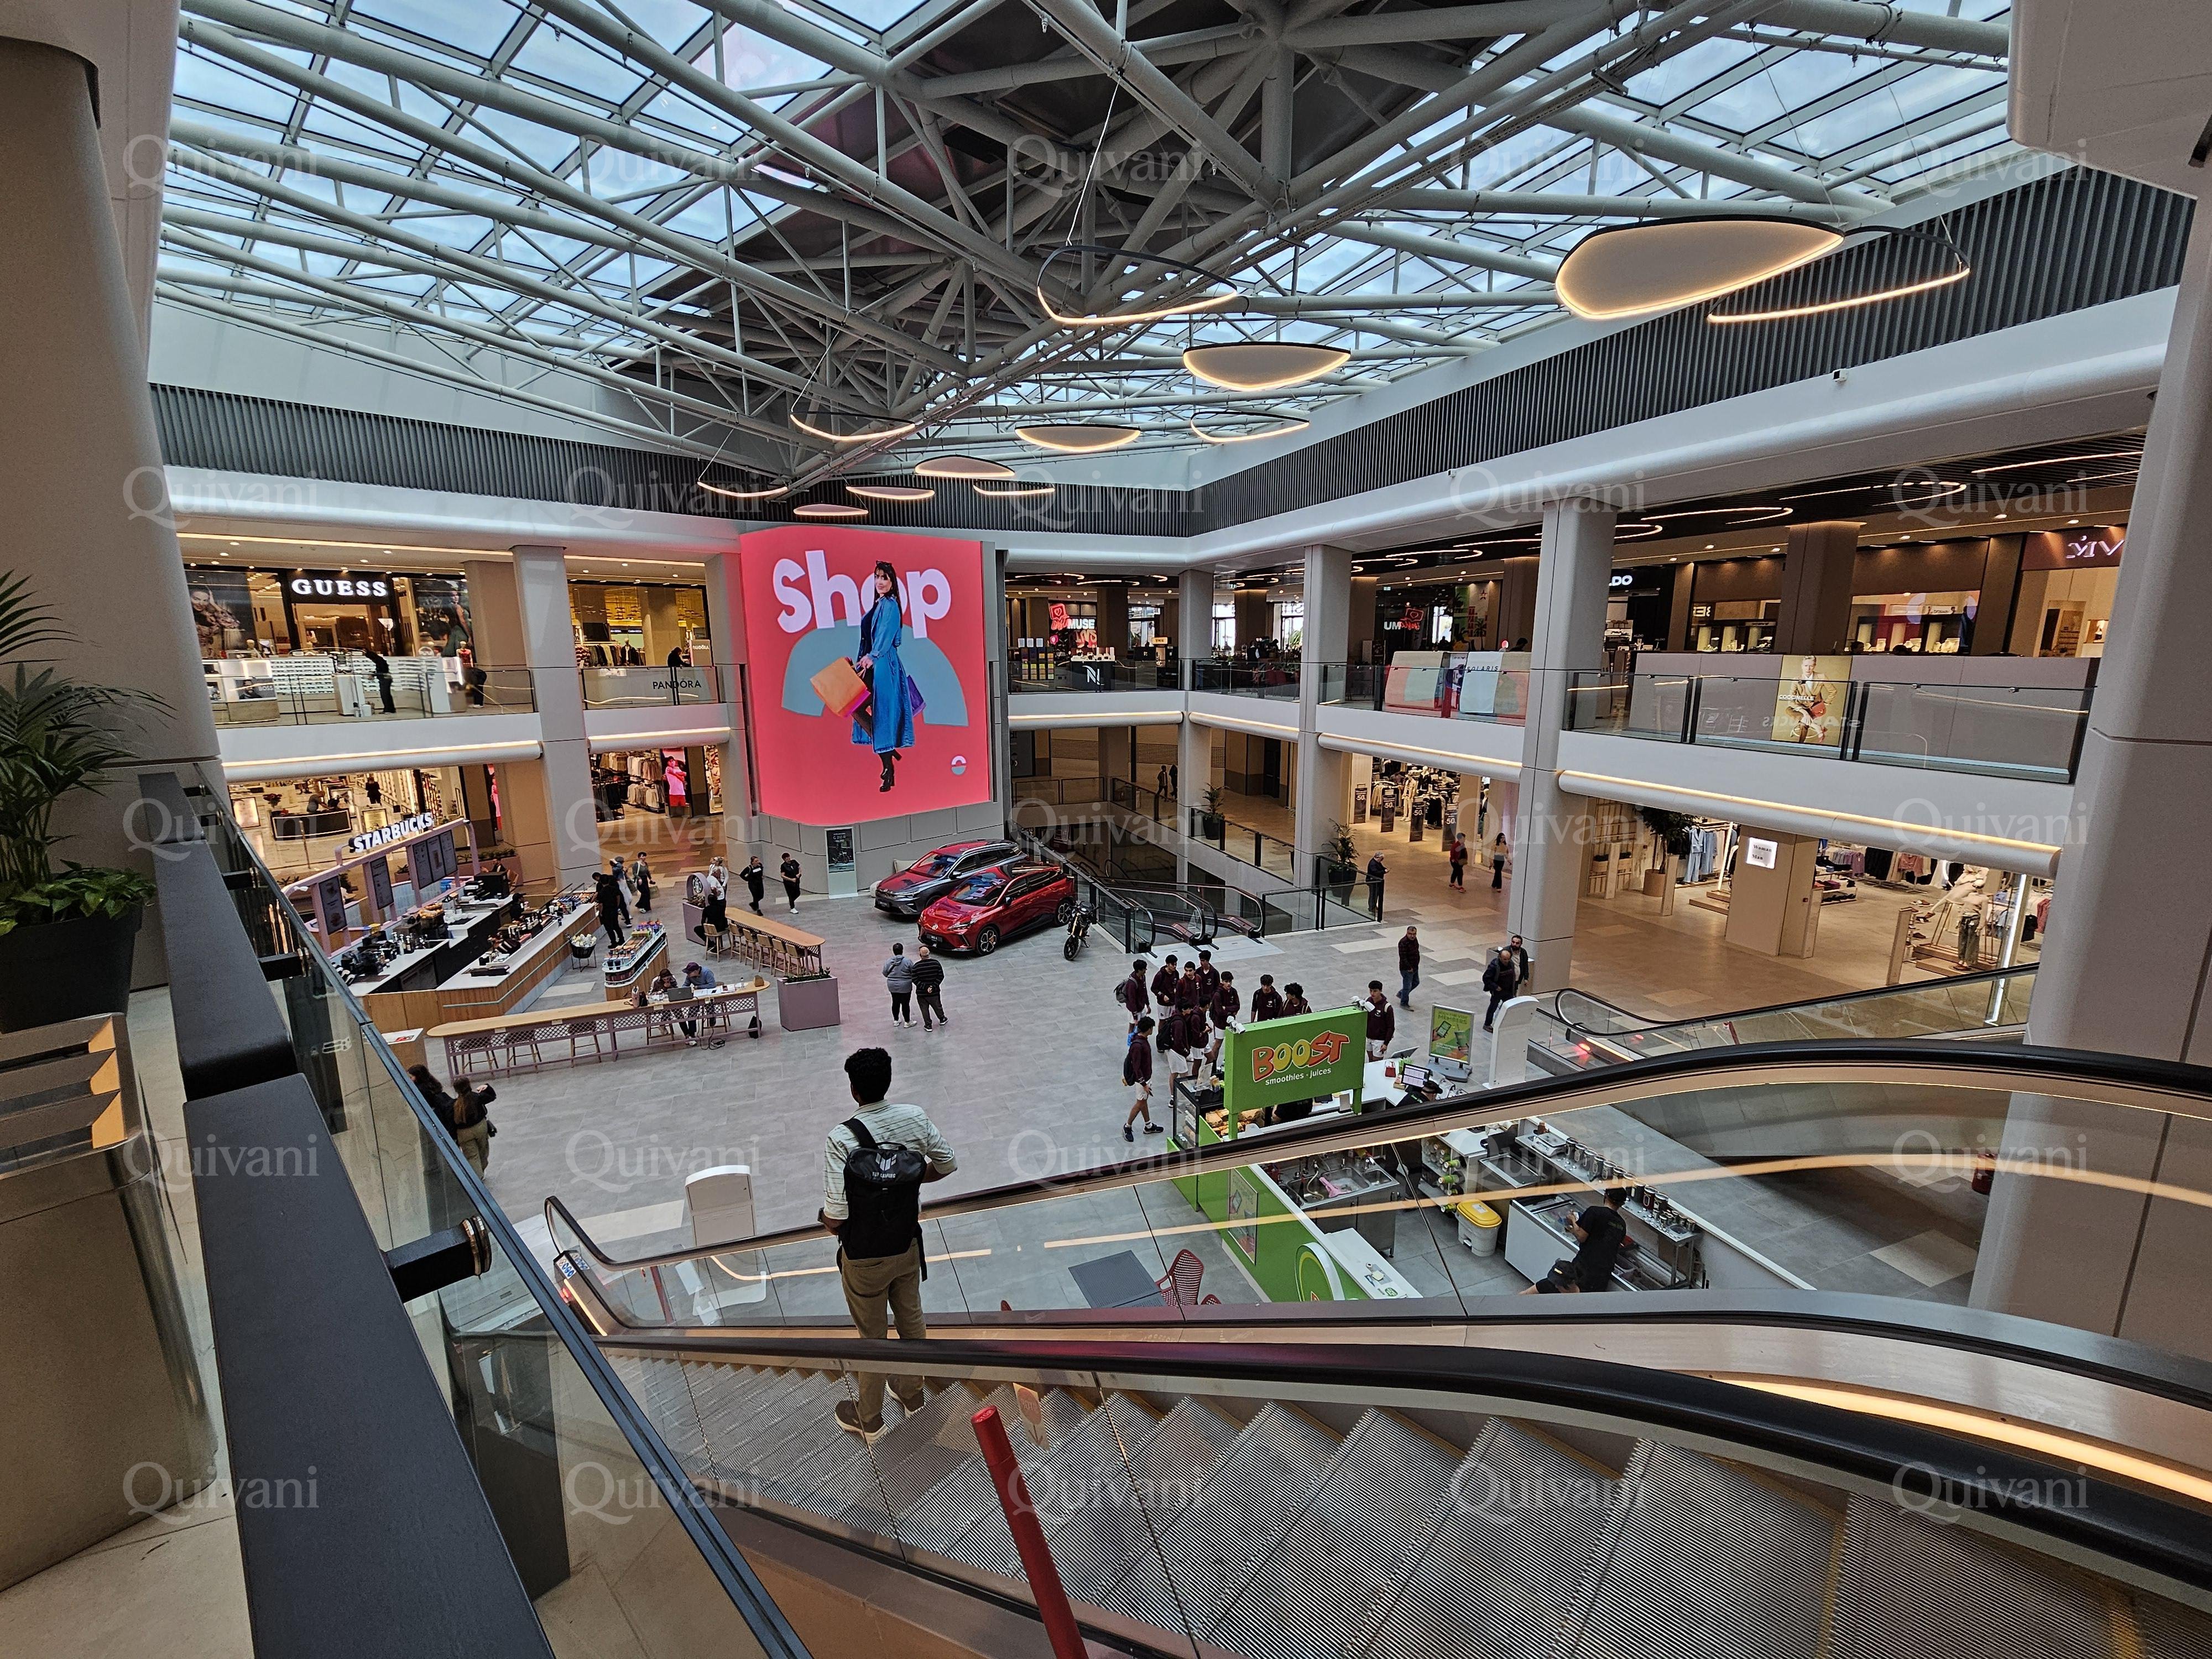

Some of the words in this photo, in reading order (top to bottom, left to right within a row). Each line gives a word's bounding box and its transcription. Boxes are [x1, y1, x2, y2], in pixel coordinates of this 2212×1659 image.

[291, 579, 387, 597] GUESS
[1609, 575, 1633, 586] DO
[1067, 619, 1095, 629] MUSE
[653, 679, 702, 689] PANDORA
[353, 812, 434, 853] STARBUCKS
[1252, 1030, 1350, 1083] BOOST
[1265, 1073, 1304, 1086] smoothies
[1310, 1068, 1332, 1079] juices
